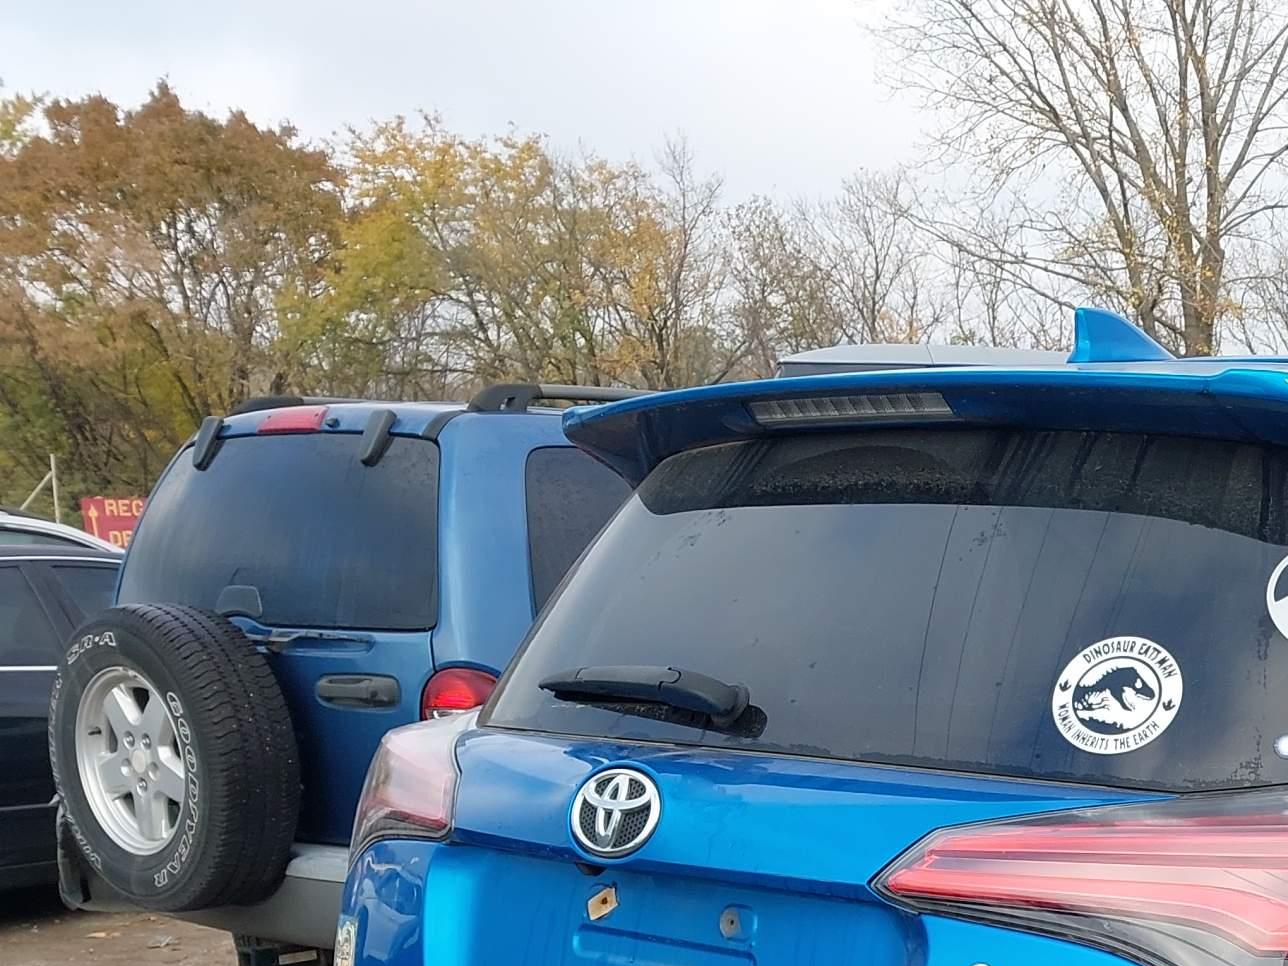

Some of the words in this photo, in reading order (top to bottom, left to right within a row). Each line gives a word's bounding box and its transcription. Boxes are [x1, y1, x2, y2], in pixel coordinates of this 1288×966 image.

[1082, 640, 1137, 664] DINOSAUR
[1138, 642, 1162, 661] EATS
[1155, 656, 1178, 679] MAN
[1057, 702, 1076, 734] WOMAN
[1071, 730, 1110, 750] INHERITS
[1113, 738, 1131, 750] THE
[1133, 720, 1160, 745] EARTH
[153, 691, 200, 888] GOODYEAR
